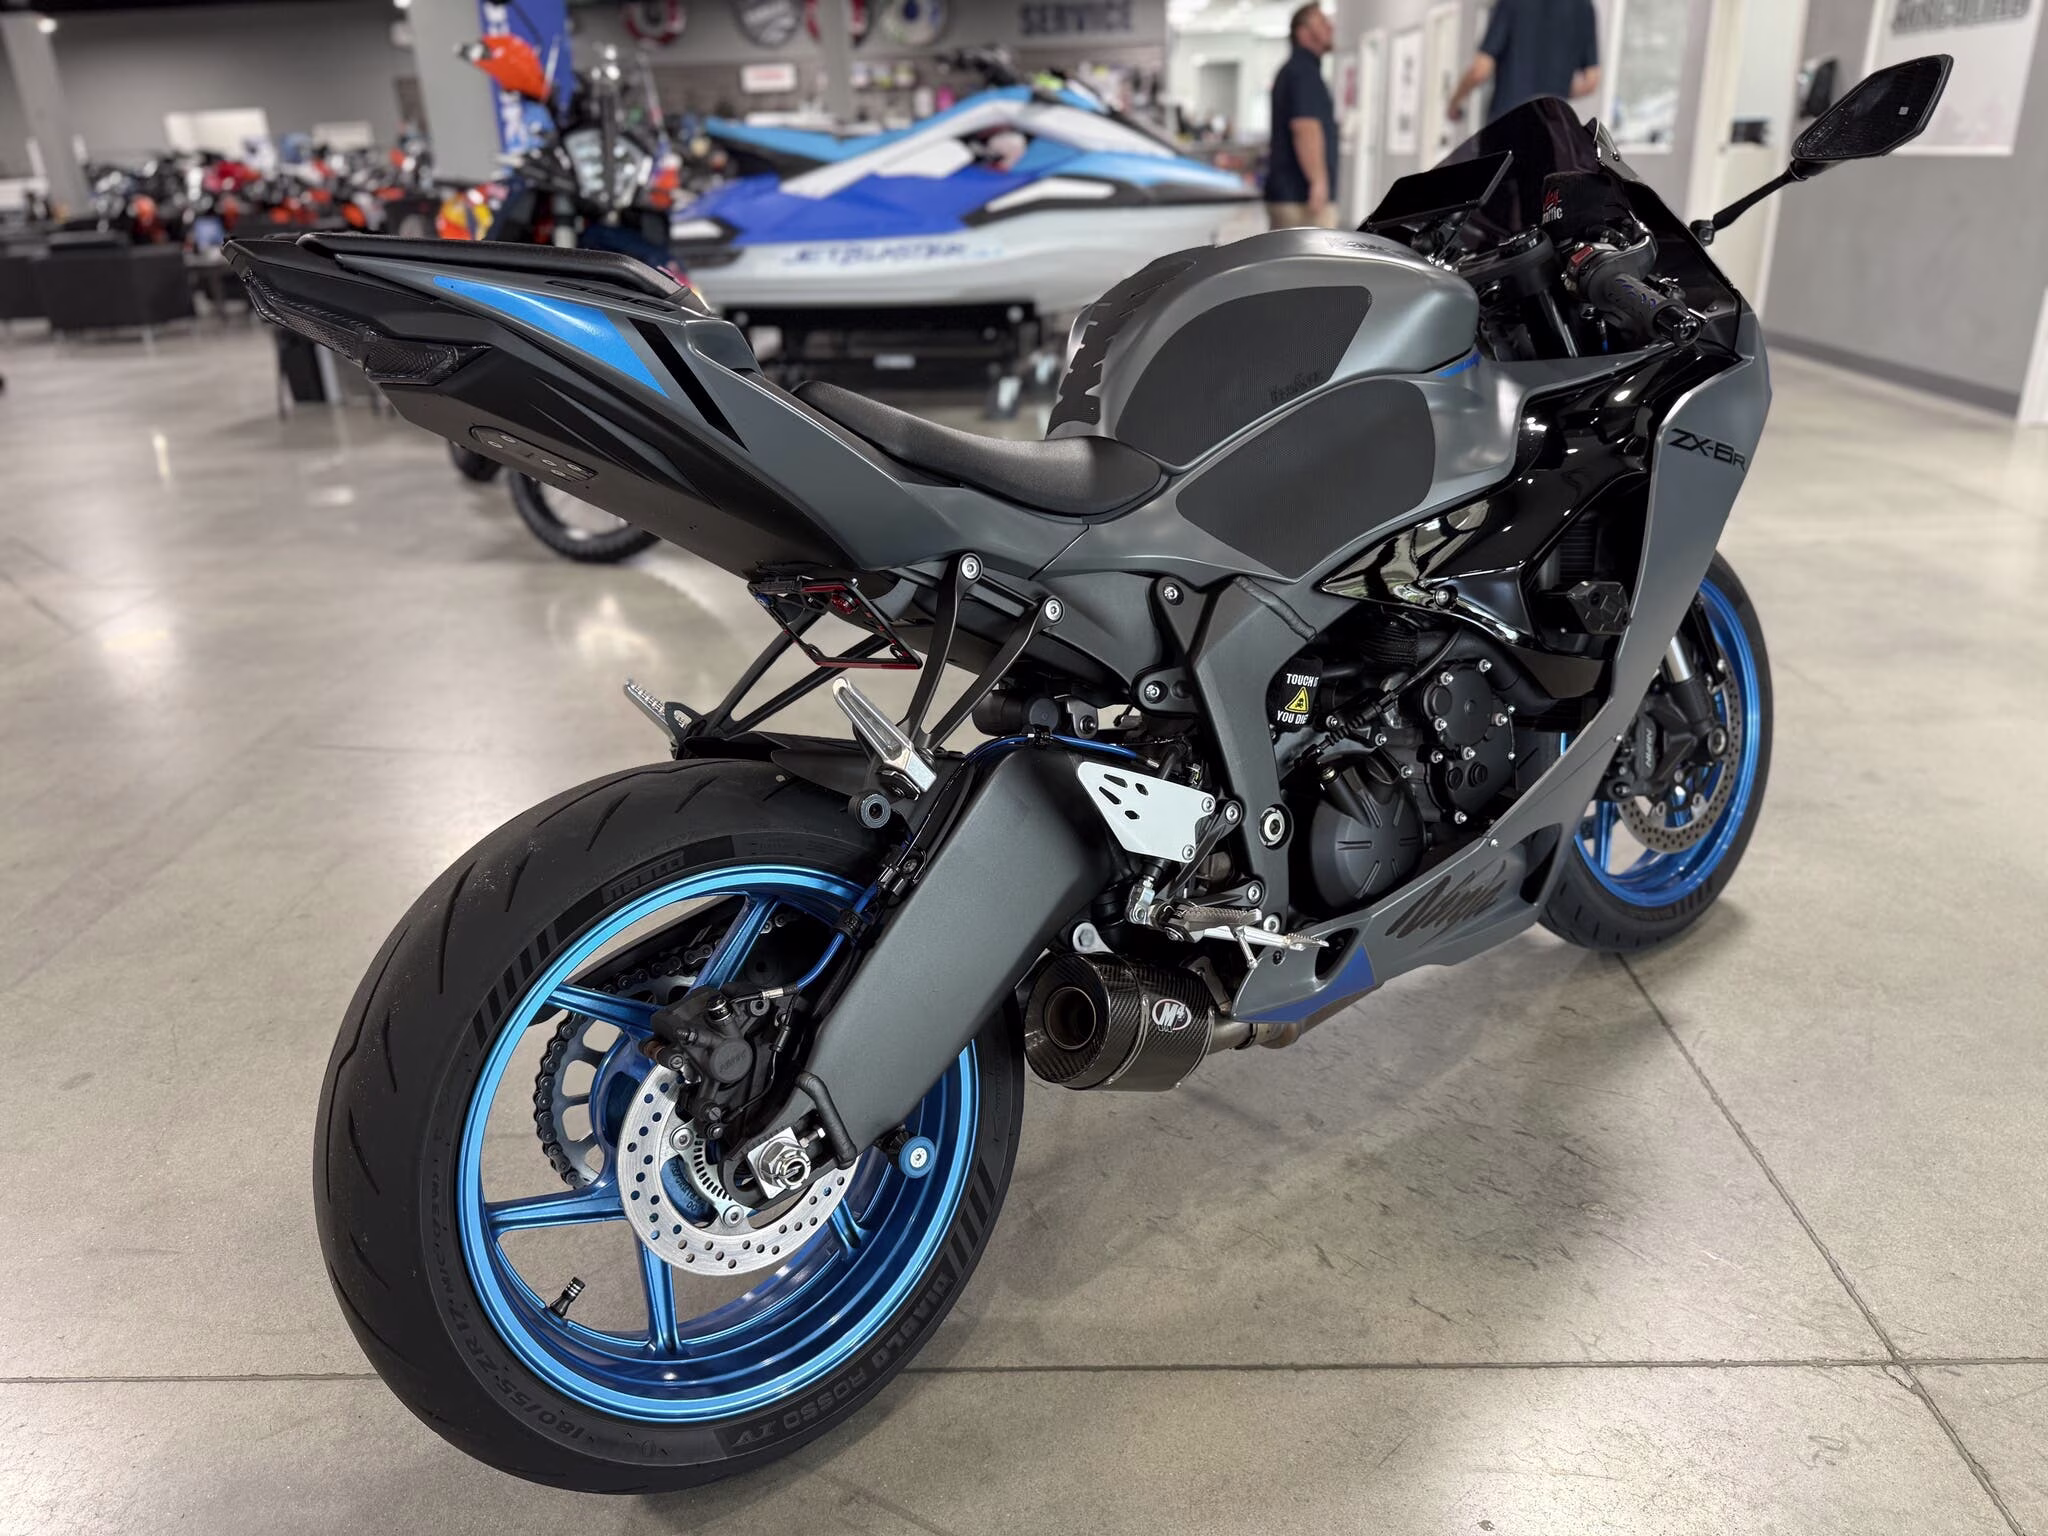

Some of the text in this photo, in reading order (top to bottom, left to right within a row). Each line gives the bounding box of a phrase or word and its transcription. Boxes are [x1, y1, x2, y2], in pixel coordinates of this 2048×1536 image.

[1668, 428, 1747, 473] ZX-6R
[1286, 673, 1314, 688] TOUCH
[1277, 710, 1294, 723] YOU
[1385, 857, 1507, 948] Ninja
[731, 1271, 950, 1447] DIABLO ROSSO IV
[498, 1378, 583, 1441] 180/55
